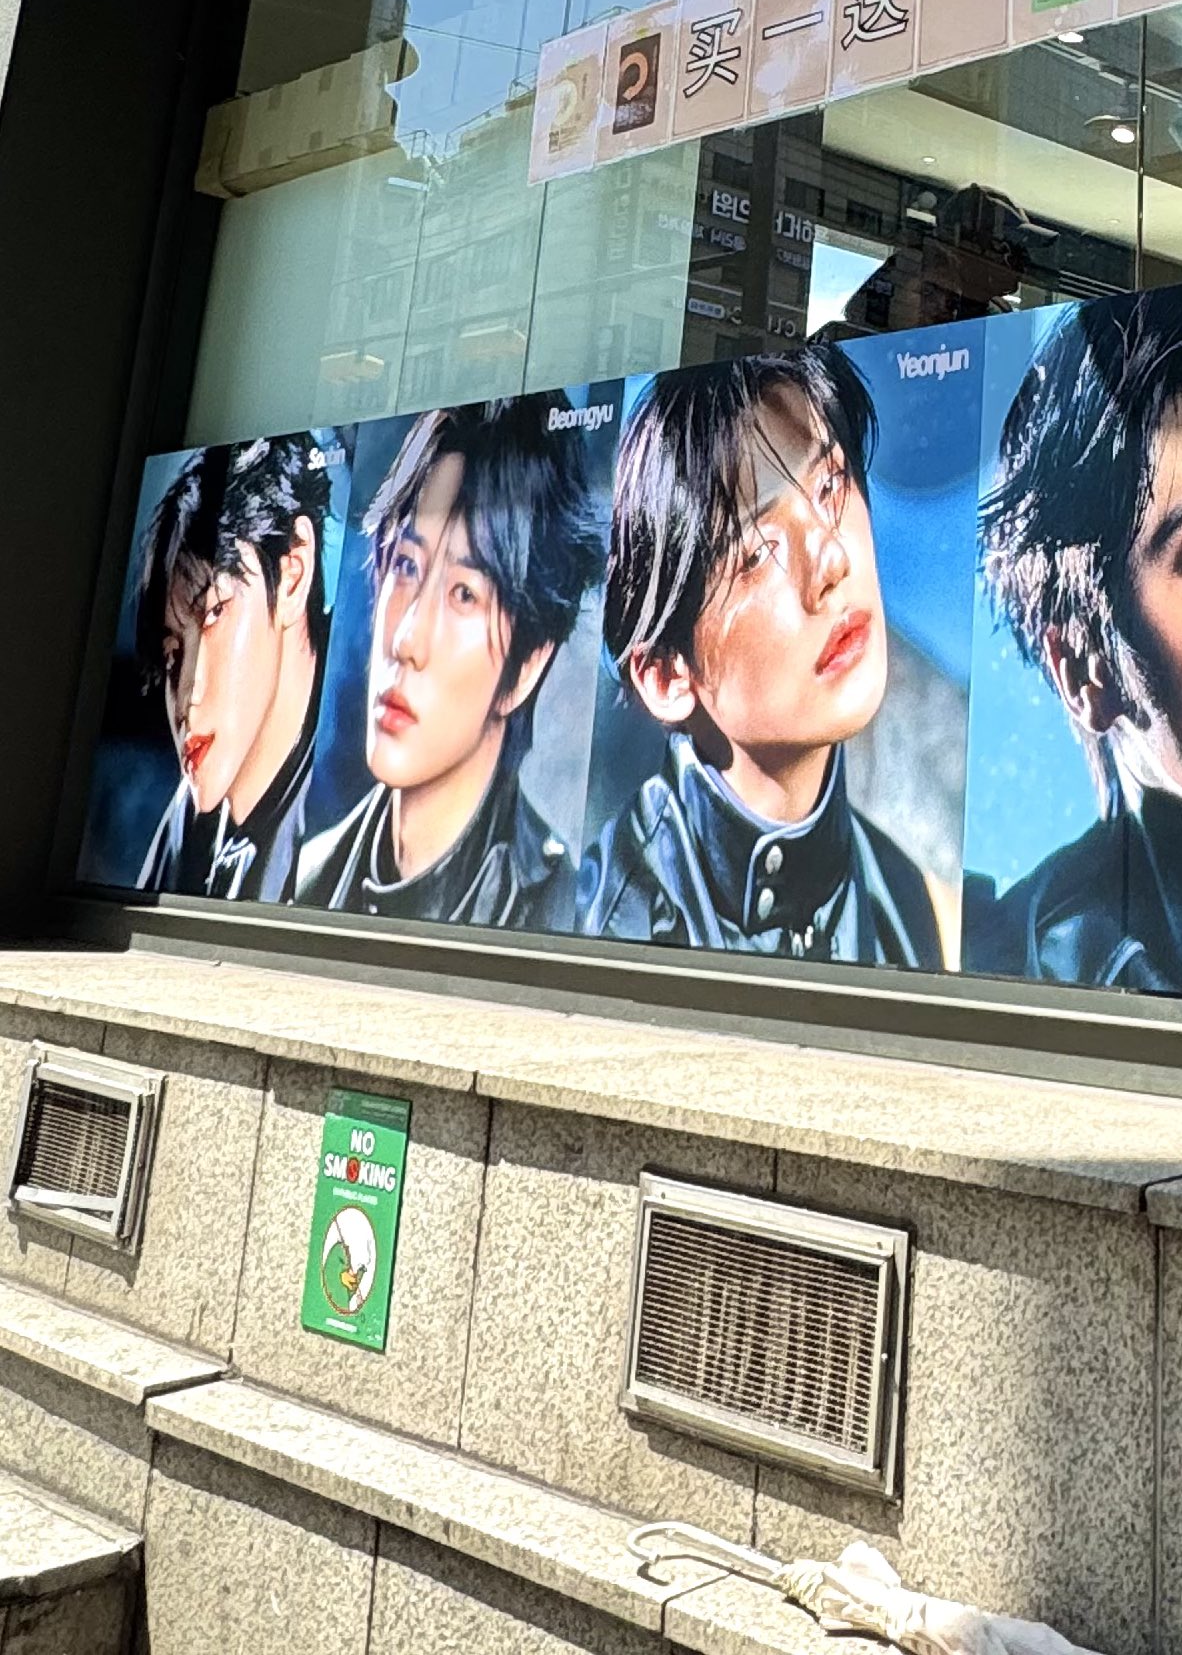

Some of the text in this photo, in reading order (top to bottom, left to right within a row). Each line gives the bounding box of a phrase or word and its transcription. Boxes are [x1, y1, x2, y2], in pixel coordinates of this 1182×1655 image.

[897, 343, 970, 381] Yeonjun
[547, 402, 614, 433] Beomgyu
[350, 1128, 376, 1156] NO
[323, 1152, 397, 1193] SMOKING
